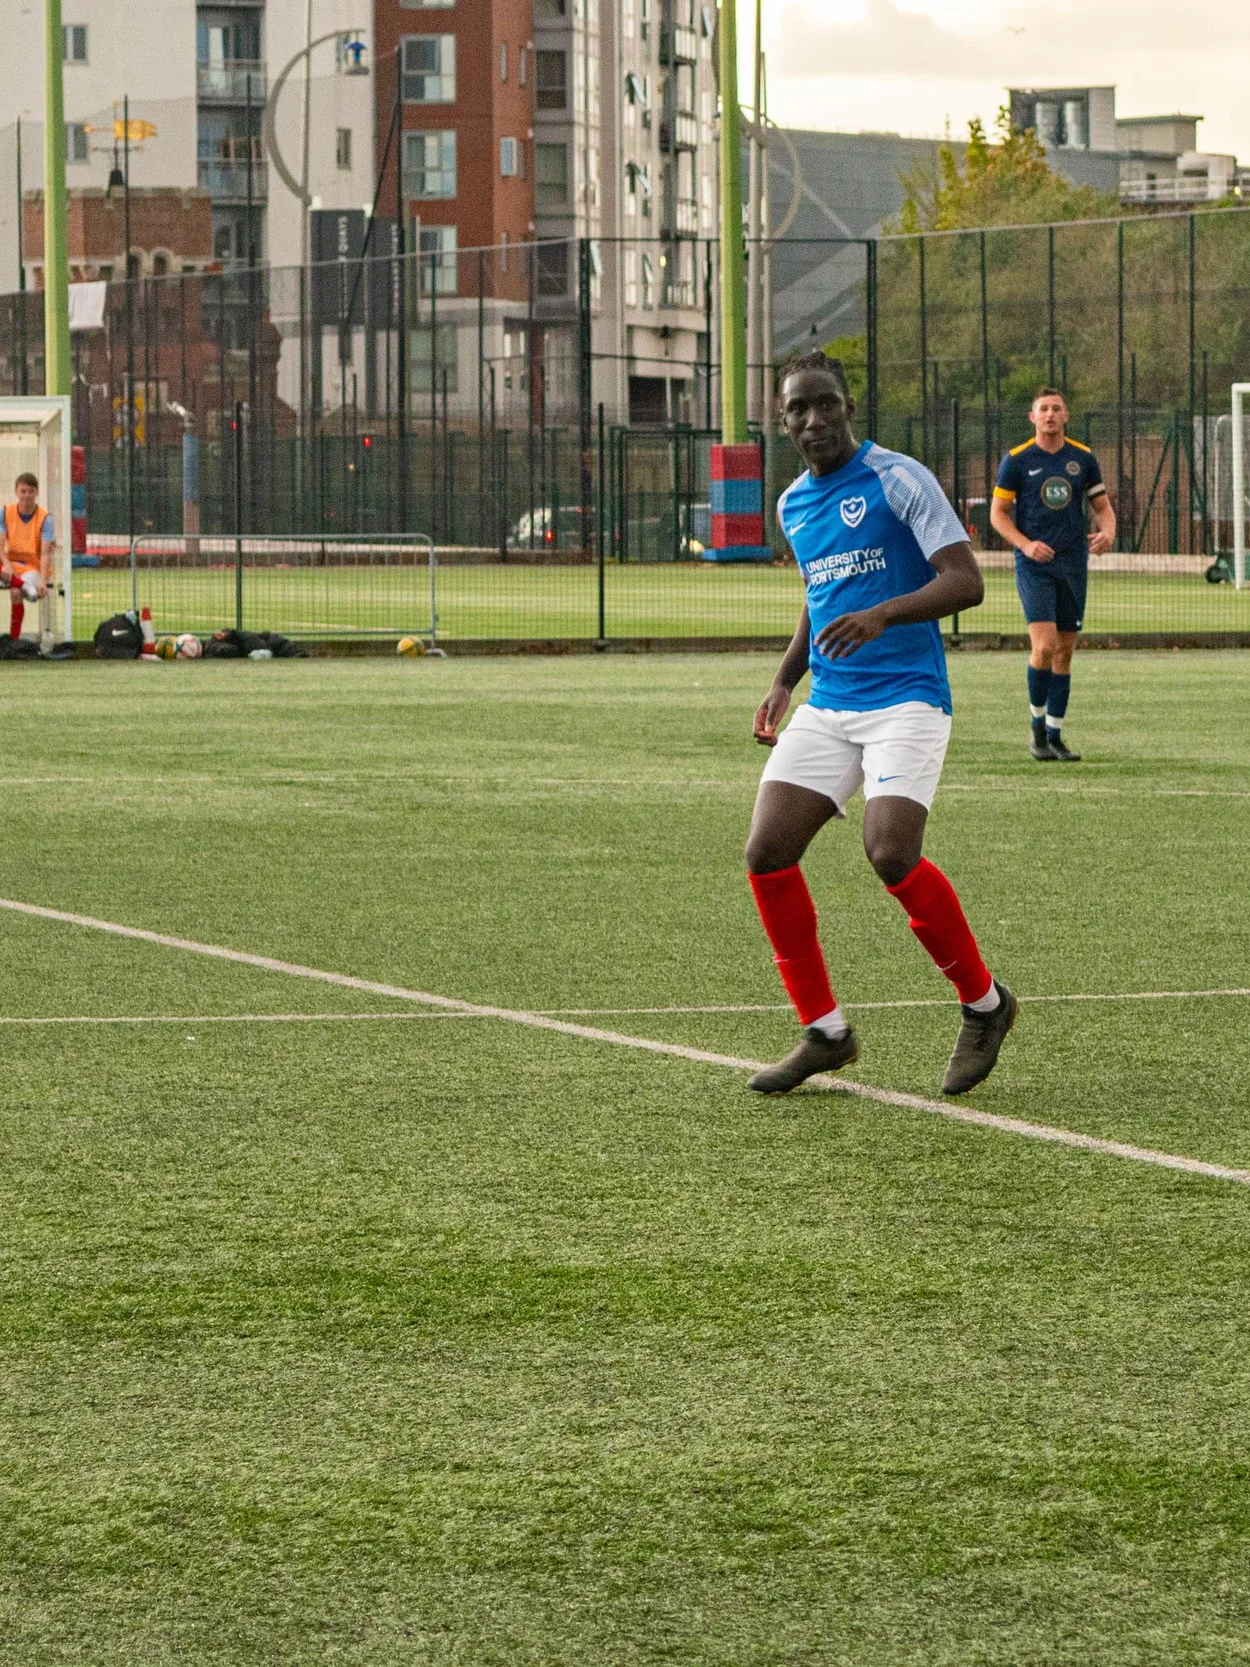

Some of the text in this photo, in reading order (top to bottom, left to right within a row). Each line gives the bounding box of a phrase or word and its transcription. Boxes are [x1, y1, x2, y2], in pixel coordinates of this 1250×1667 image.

[806, 547, 884, 574] UNIVERSITY OF
[810, 557, 886, 585] PORTSMOUTH
